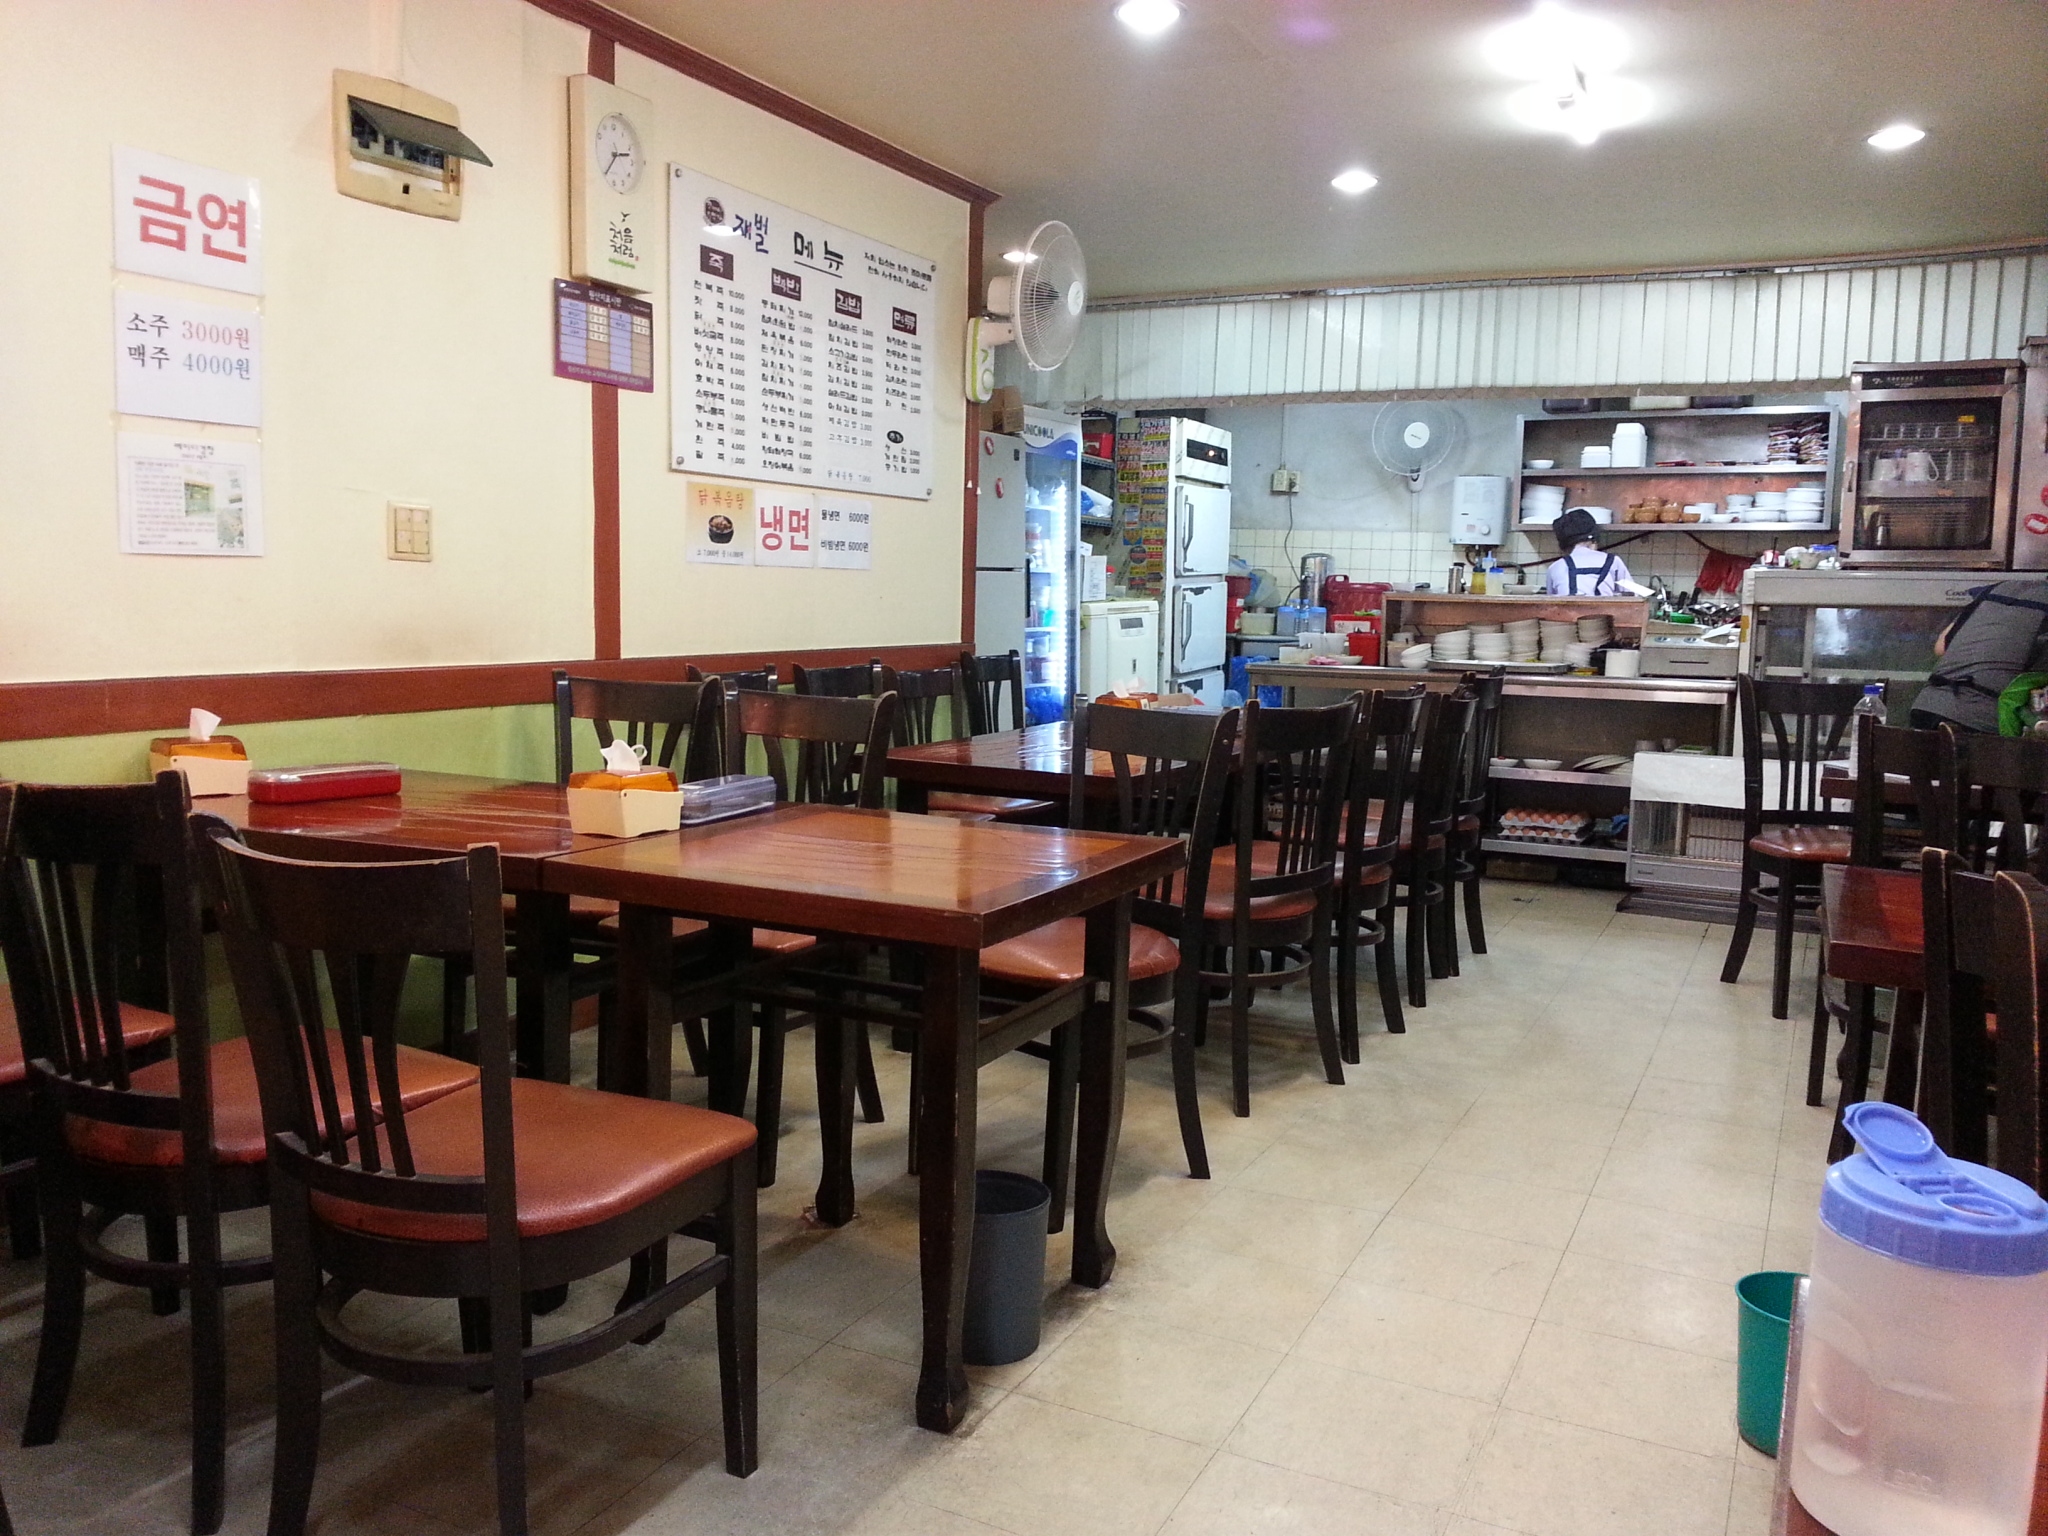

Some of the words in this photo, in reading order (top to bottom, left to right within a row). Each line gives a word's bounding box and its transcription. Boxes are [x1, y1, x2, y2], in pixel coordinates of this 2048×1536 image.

[133, 175, 246, 263] 금연
[609, 221, 634, 244] 처음
[610, 239, 635, 258] 처럼
[794, 231, 844, 271] 메뉴
[709, 253, 724, 273] 죽
[773, 273, 800, 296] 백반
[837, 293, 860, 314] 김밥
[127, 313, 170, 338] 소주
[181, 320, 250, 350] 3000원
[894, 311, 916, 331] 면류
[127, 344, 170, 369] 맥주
[182, 353, 251, 380] 4000원
[821, 509, 840, 522] 물냉면
[849, 512, 870, 524] 6000원
[760, 506, 810, 551] 냉면
[820, 539, 846, 552] 비빔냉면
[848, 541, 869, 553] 6000원
